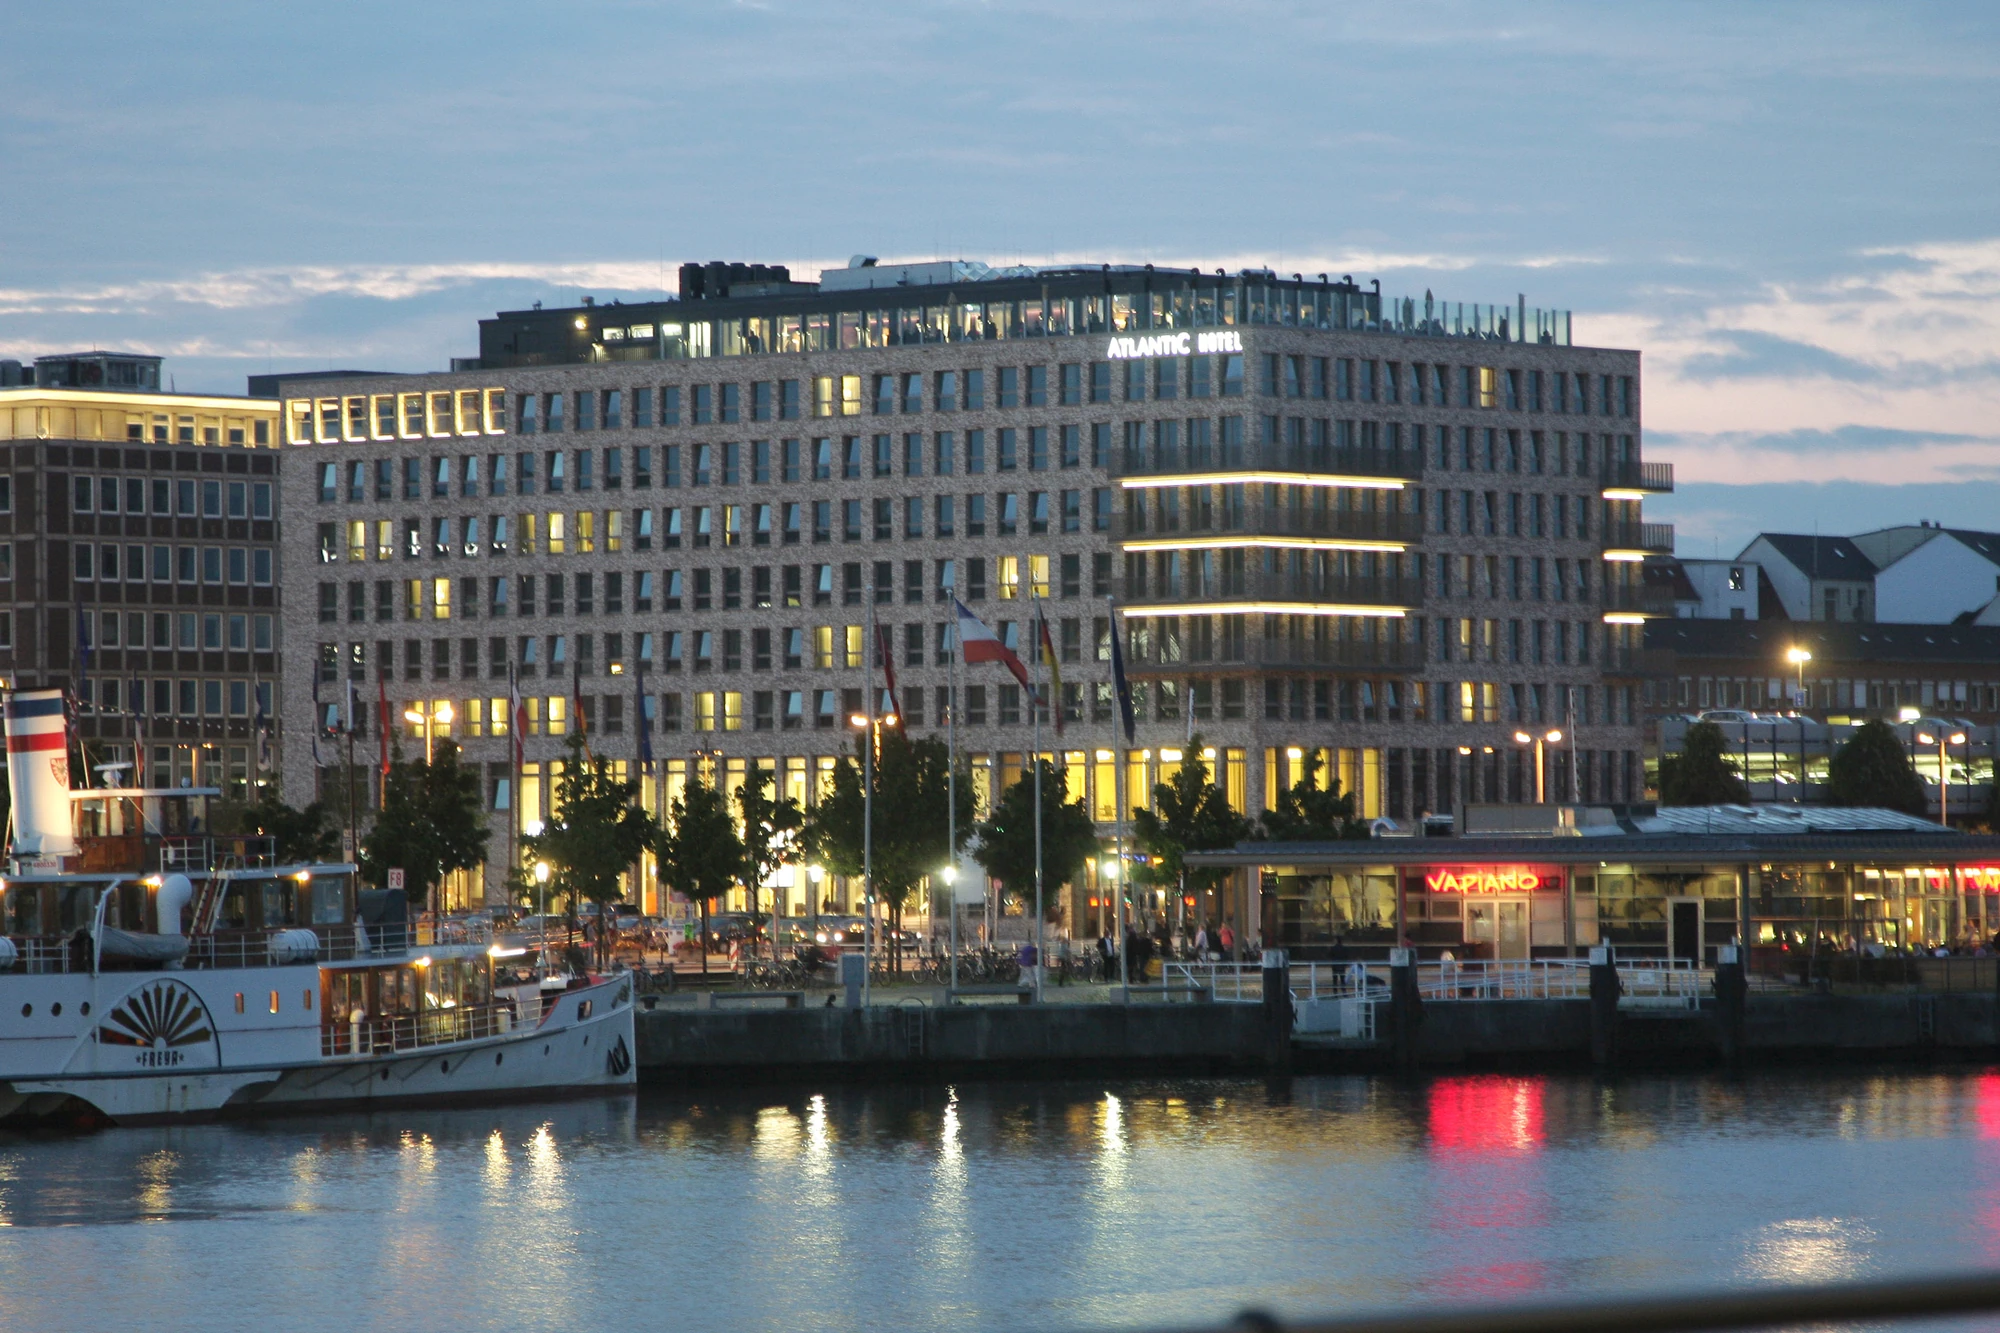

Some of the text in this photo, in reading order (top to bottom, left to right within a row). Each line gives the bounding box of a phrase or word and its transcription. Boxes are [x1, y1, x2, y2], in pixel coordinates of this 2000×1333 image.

[1107, 331, 1243, 358] ATLANTIC HOTEL
[390, 872, 402, 886] F8
[1426, 868, 1539, 894] VAPIANO
[142, 1051, 179, 1067] FREYA
